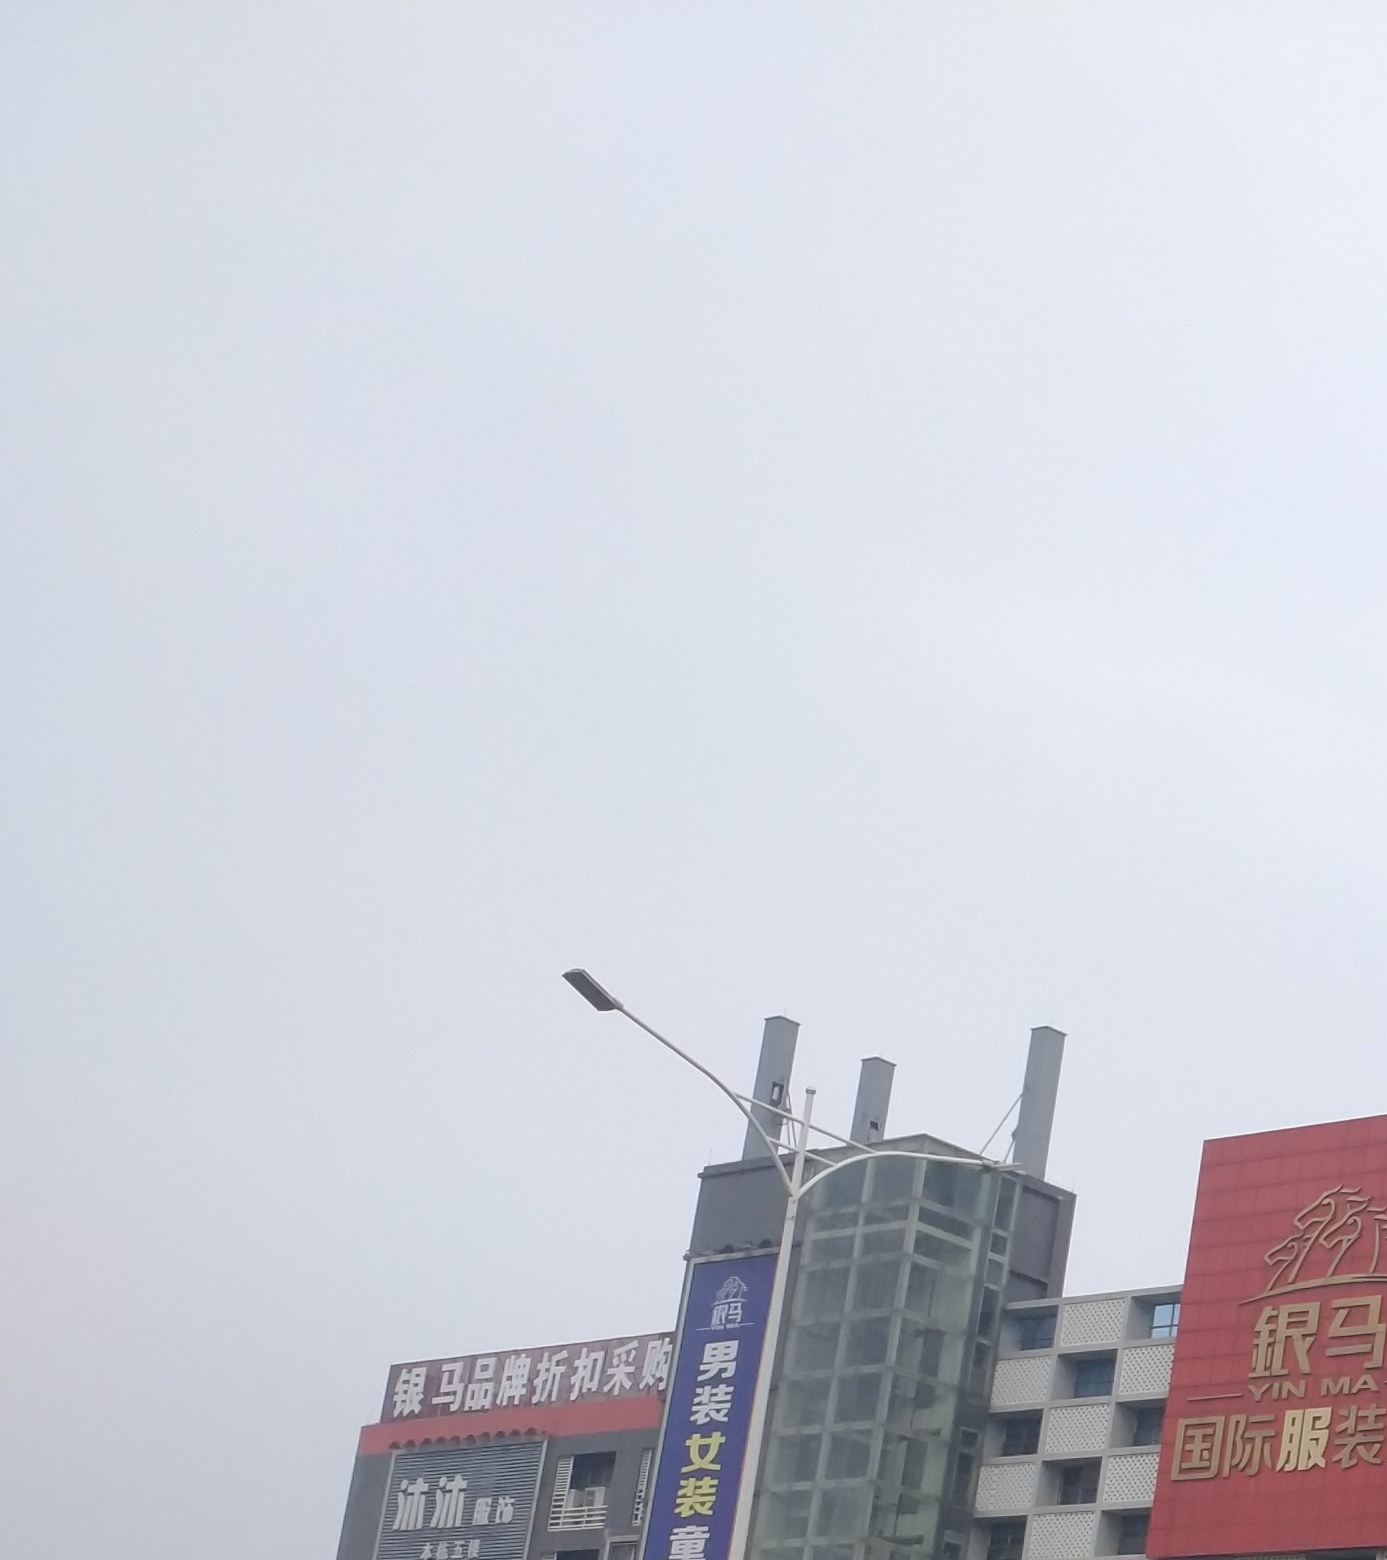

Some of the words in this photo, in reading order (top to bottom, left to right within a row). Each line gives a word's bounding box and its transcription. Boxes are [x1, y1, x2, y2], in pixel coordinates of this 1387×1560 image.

[1248, 1294, 1387, 1379] 银马
[393, 1337, 673, 1418] 银马品牌折扣采购
[1247, 1379, 1307, 1402] YIN
[1320, 1374, 1380, 1397] MA
